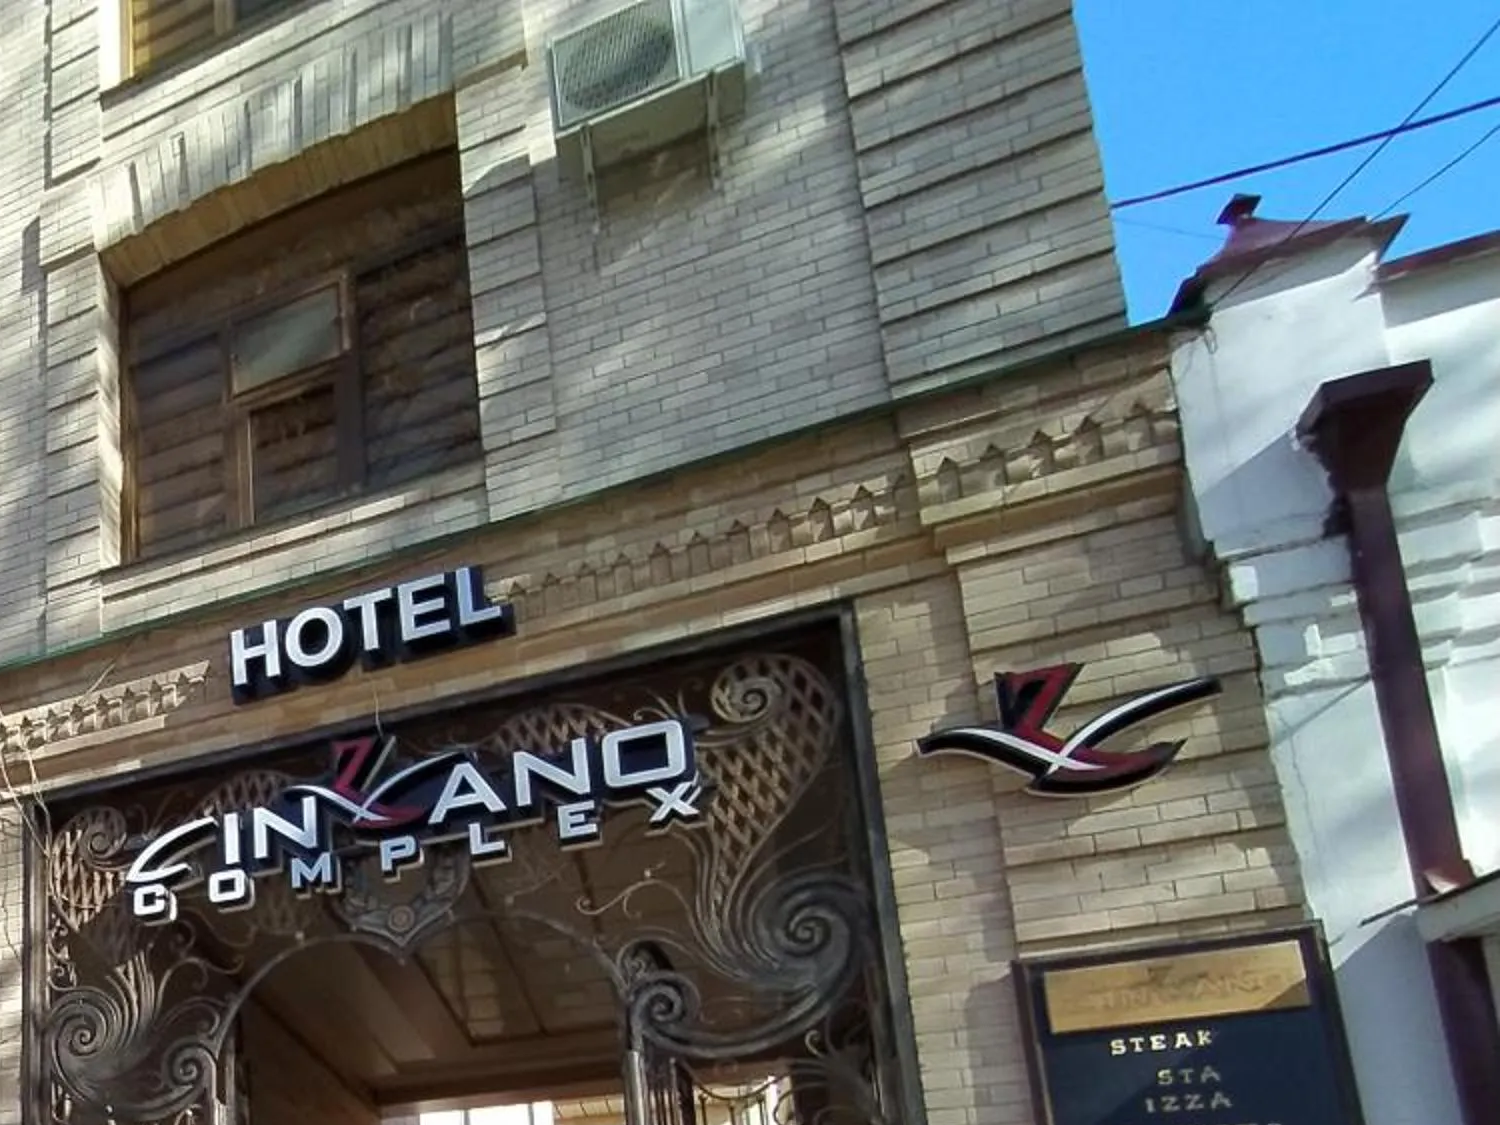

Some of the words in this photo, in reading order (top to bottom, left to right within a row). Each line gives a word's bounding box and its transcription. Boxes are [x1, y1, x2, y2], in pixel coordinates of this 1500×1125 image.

[230, 565, 503, 687] HOTEL
[125, 718, 687, 883] CINZANO
[133, 782, 700, 918] COMPLEX
[1110, 1029, 1213, 1056] STEAK
